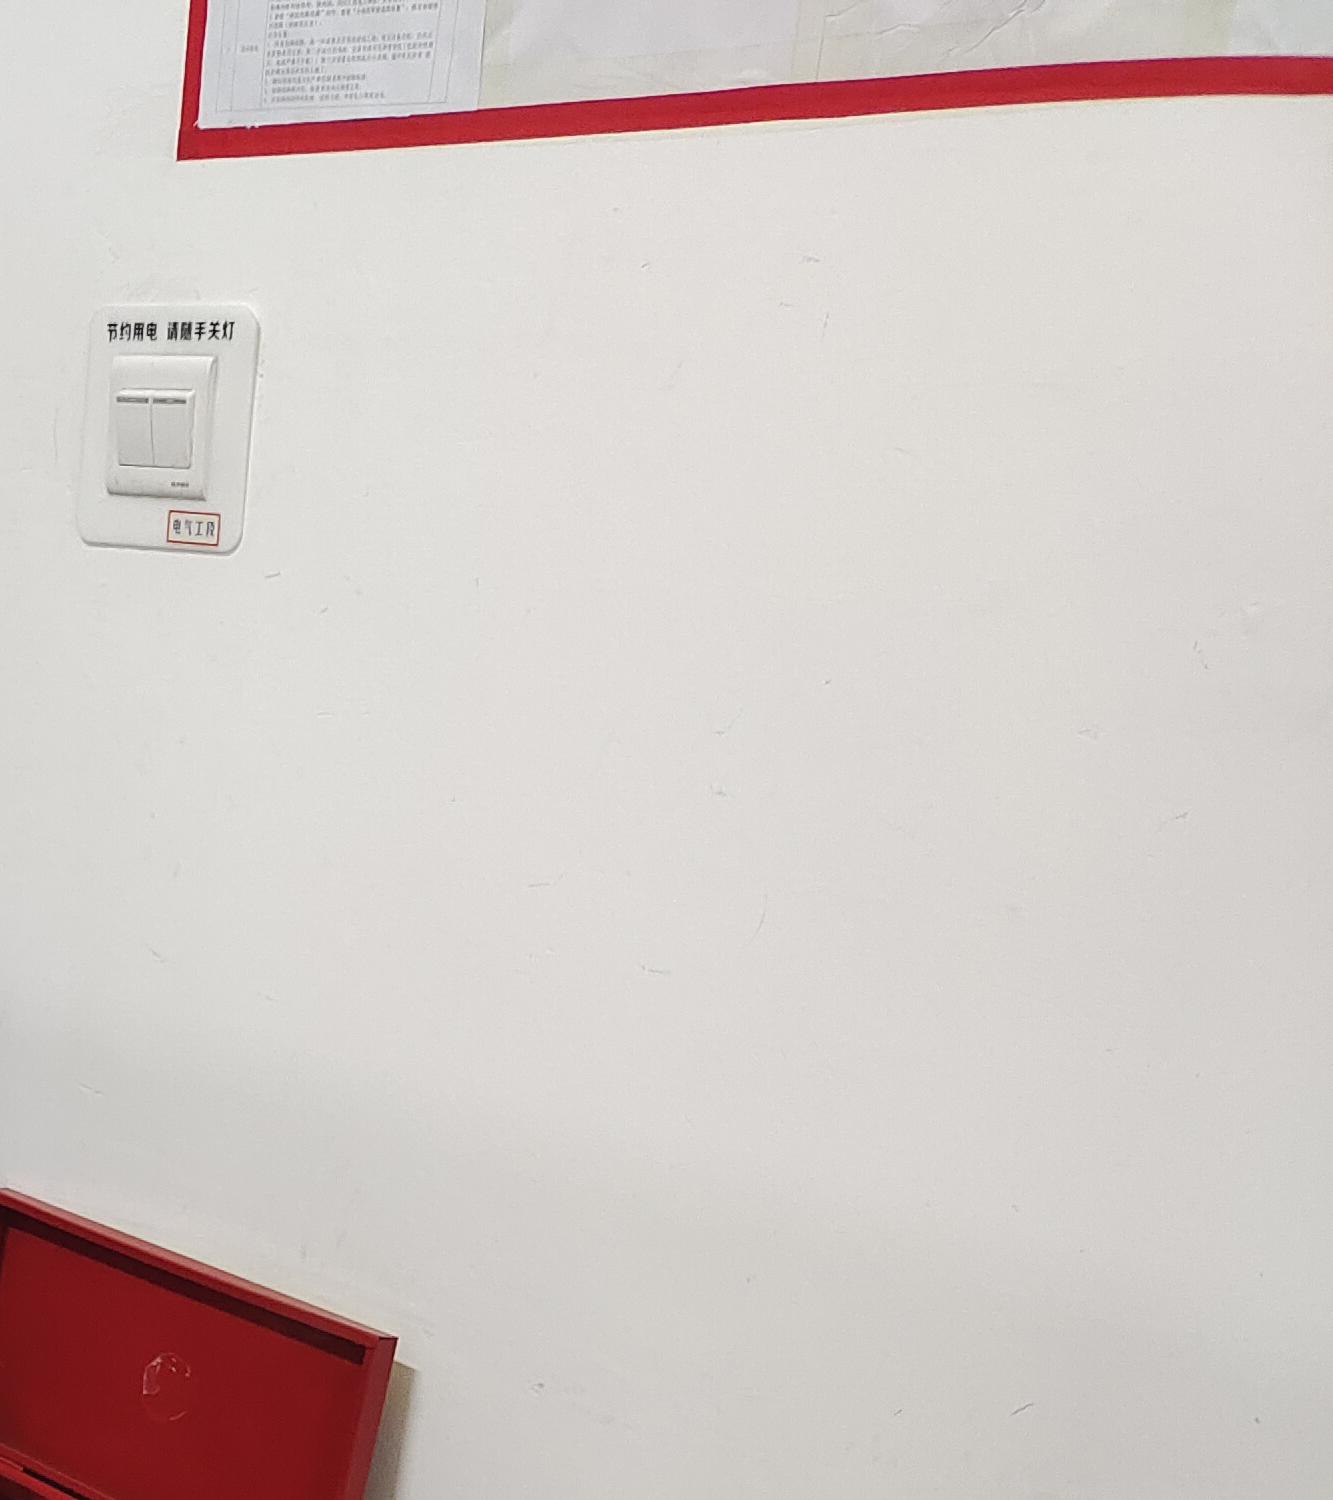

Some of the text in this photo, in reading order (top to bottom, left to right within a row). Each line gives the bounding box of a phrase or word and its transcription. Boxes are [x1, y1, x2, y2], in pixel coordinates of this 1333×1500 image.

[106, 320, 236, 342] 节约用电 请随手关灯
